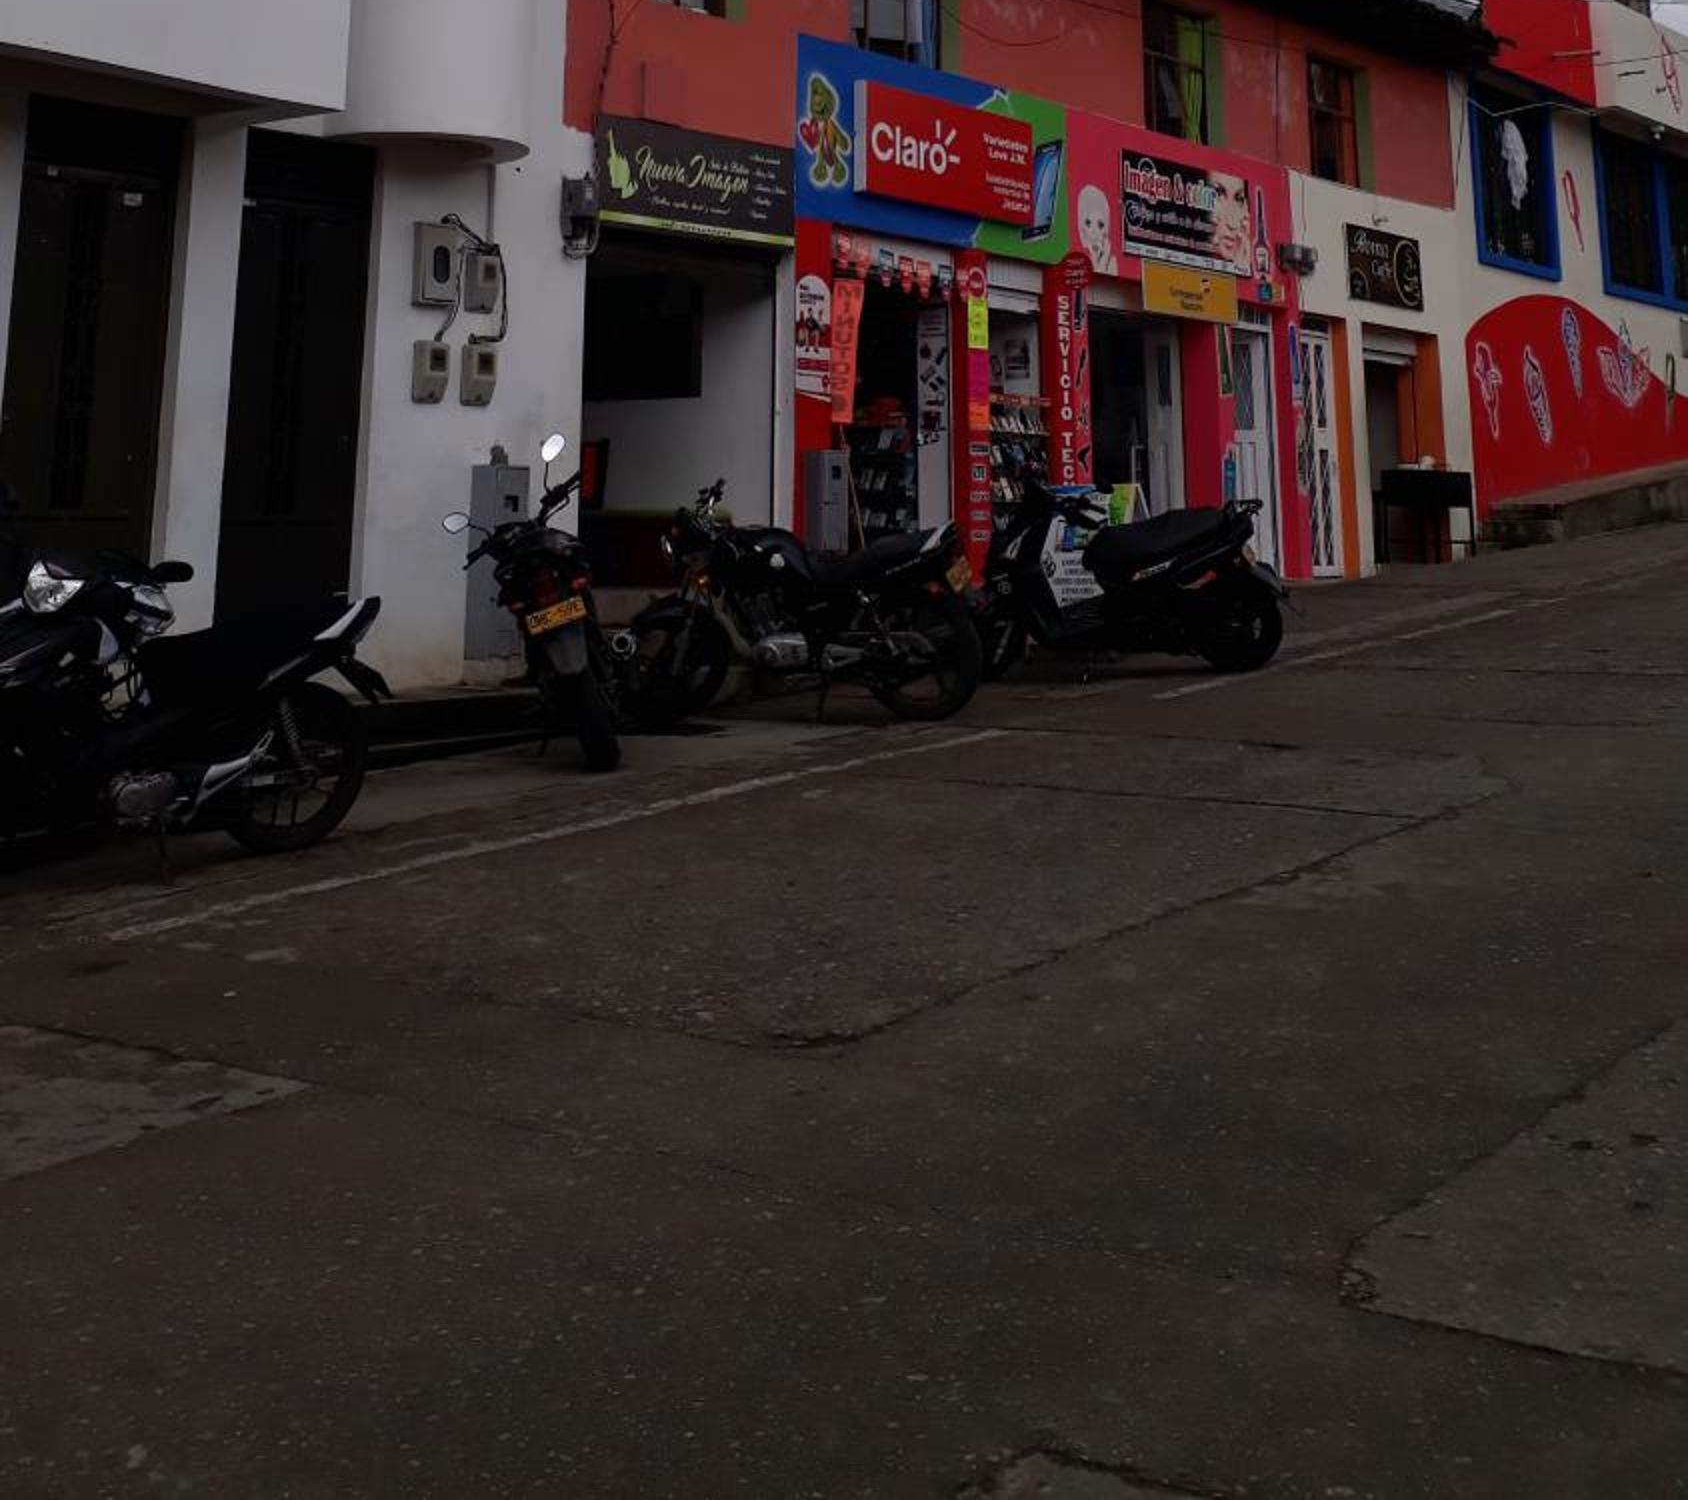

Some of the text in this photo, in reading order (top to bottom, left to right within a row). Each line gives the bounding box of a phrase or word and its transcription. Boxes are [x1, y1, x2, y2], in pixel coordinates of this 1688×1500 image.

[635, 145, 749, 202] Nueva Imagen
[871, 119, 960, 175] Claro
[1124, 160, 1172, 203] Imagen
[1057, 295, 1076, 485] SERVICIO TEC
